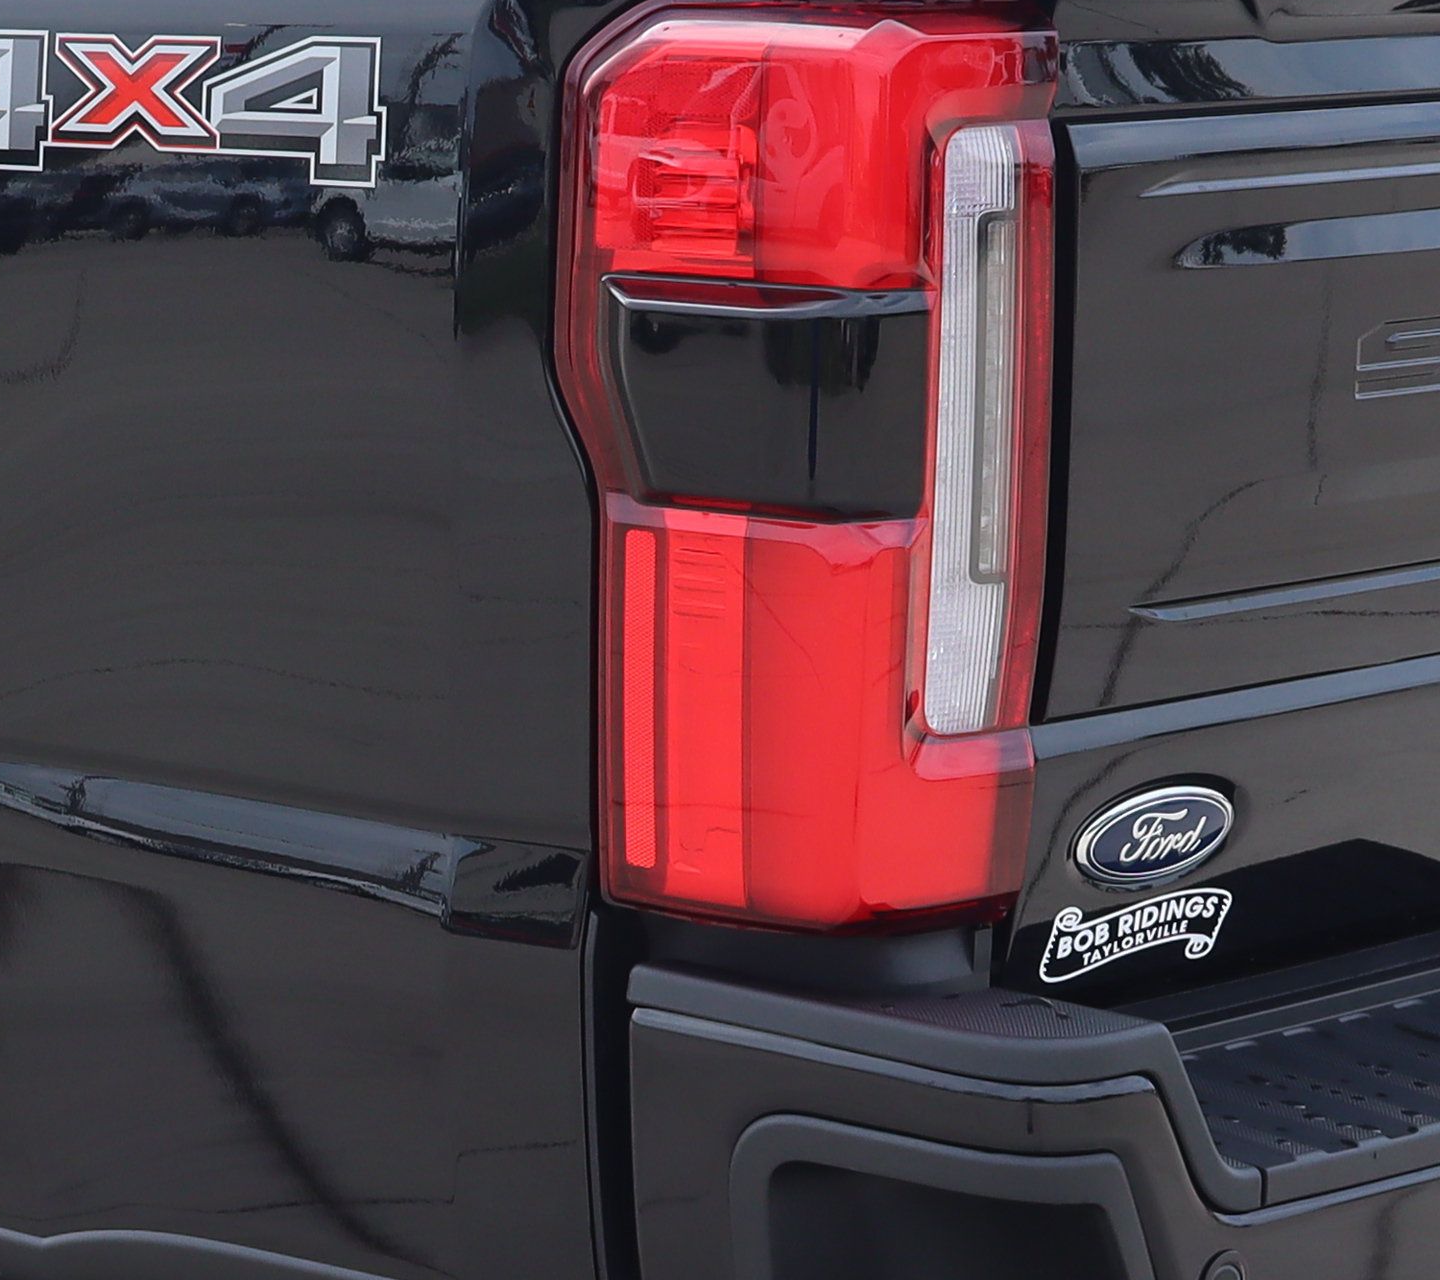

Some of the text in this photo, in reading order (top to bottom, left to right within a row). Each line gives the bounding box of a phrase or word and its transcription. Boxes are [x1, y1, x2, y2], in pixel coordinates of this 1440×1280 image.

[1119, 807, 1208, 862] Ford
[1056, 894, 1219, 960] BOB RIDINGS
[1082, 919, 1189, 966] TAYLORVILLE
